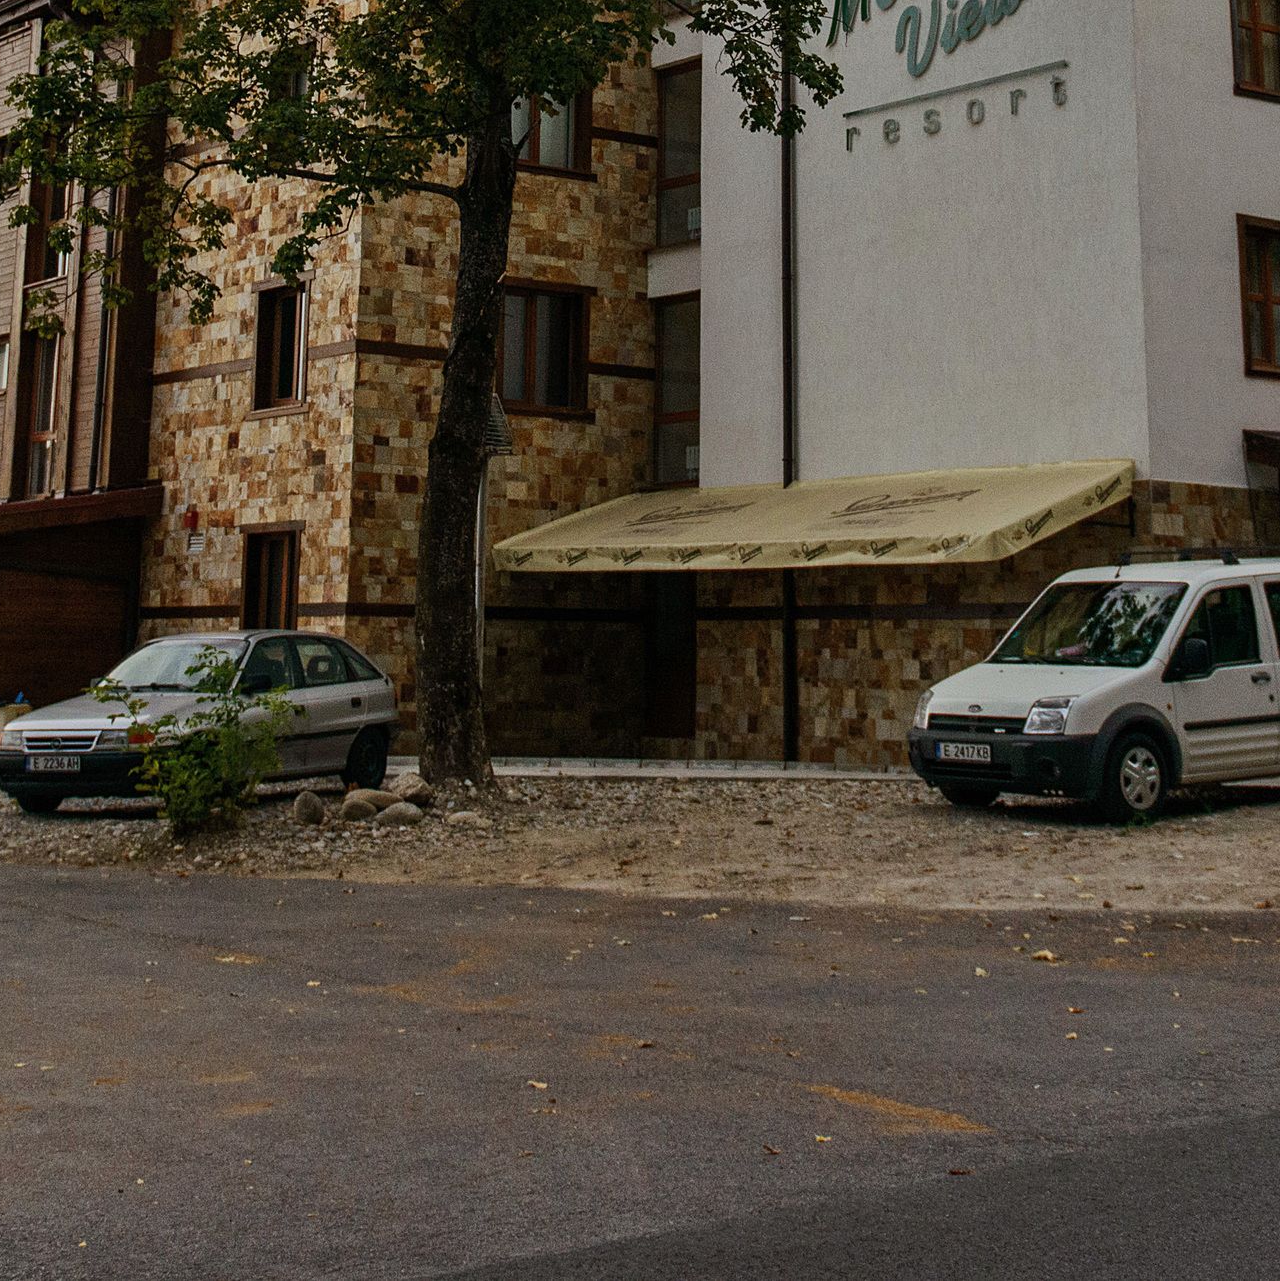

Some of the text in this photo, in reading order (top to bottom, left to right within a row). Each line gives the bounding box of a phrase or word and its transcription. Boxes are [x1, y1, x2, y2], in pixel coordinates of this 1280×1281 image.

[845, 74, 1068, 153] resort
[943, 745, 950, 757] E
[33, 757, 40, 770] E
